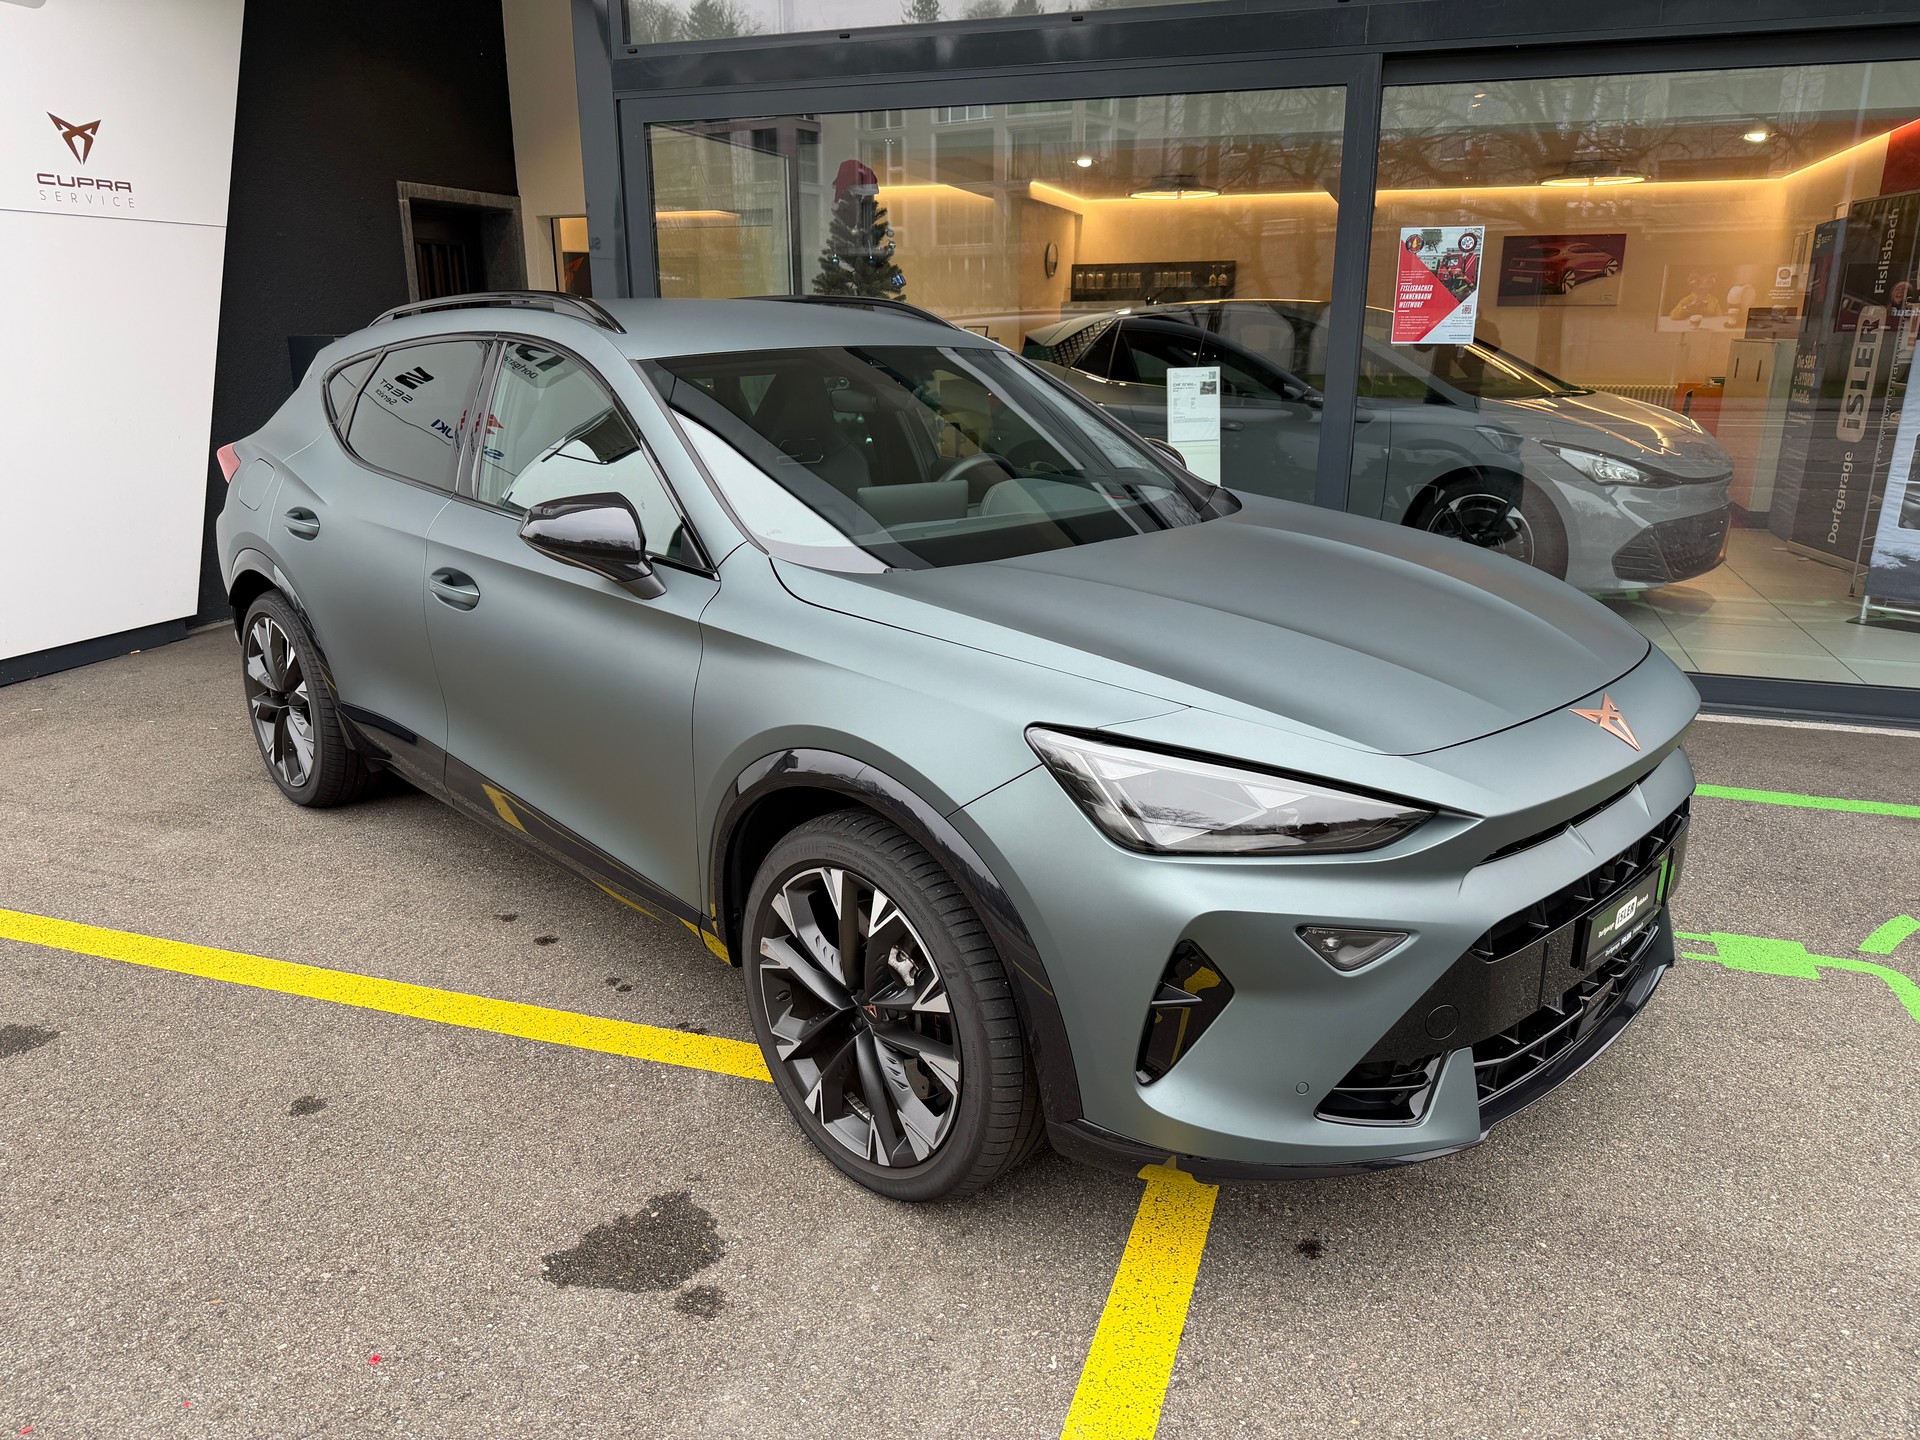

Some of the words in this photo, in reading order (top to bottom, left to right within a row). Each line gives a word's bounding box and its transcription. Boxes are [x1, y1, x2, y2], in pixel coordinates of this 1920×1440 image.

[36, 172, 132, 193] CUPRA
[39, 189, 135, 208] SERVICE
[1874, 208, 1900, 294] Fislisbach
[1399, 292, 1432, 300] TANNENBAUM
[1400, 284, 1434, 292] FISLISBACHER
[1398, 301, 1424, 309] WEITWURF
[1827, 451, 1854, 545] Dorfgarage
